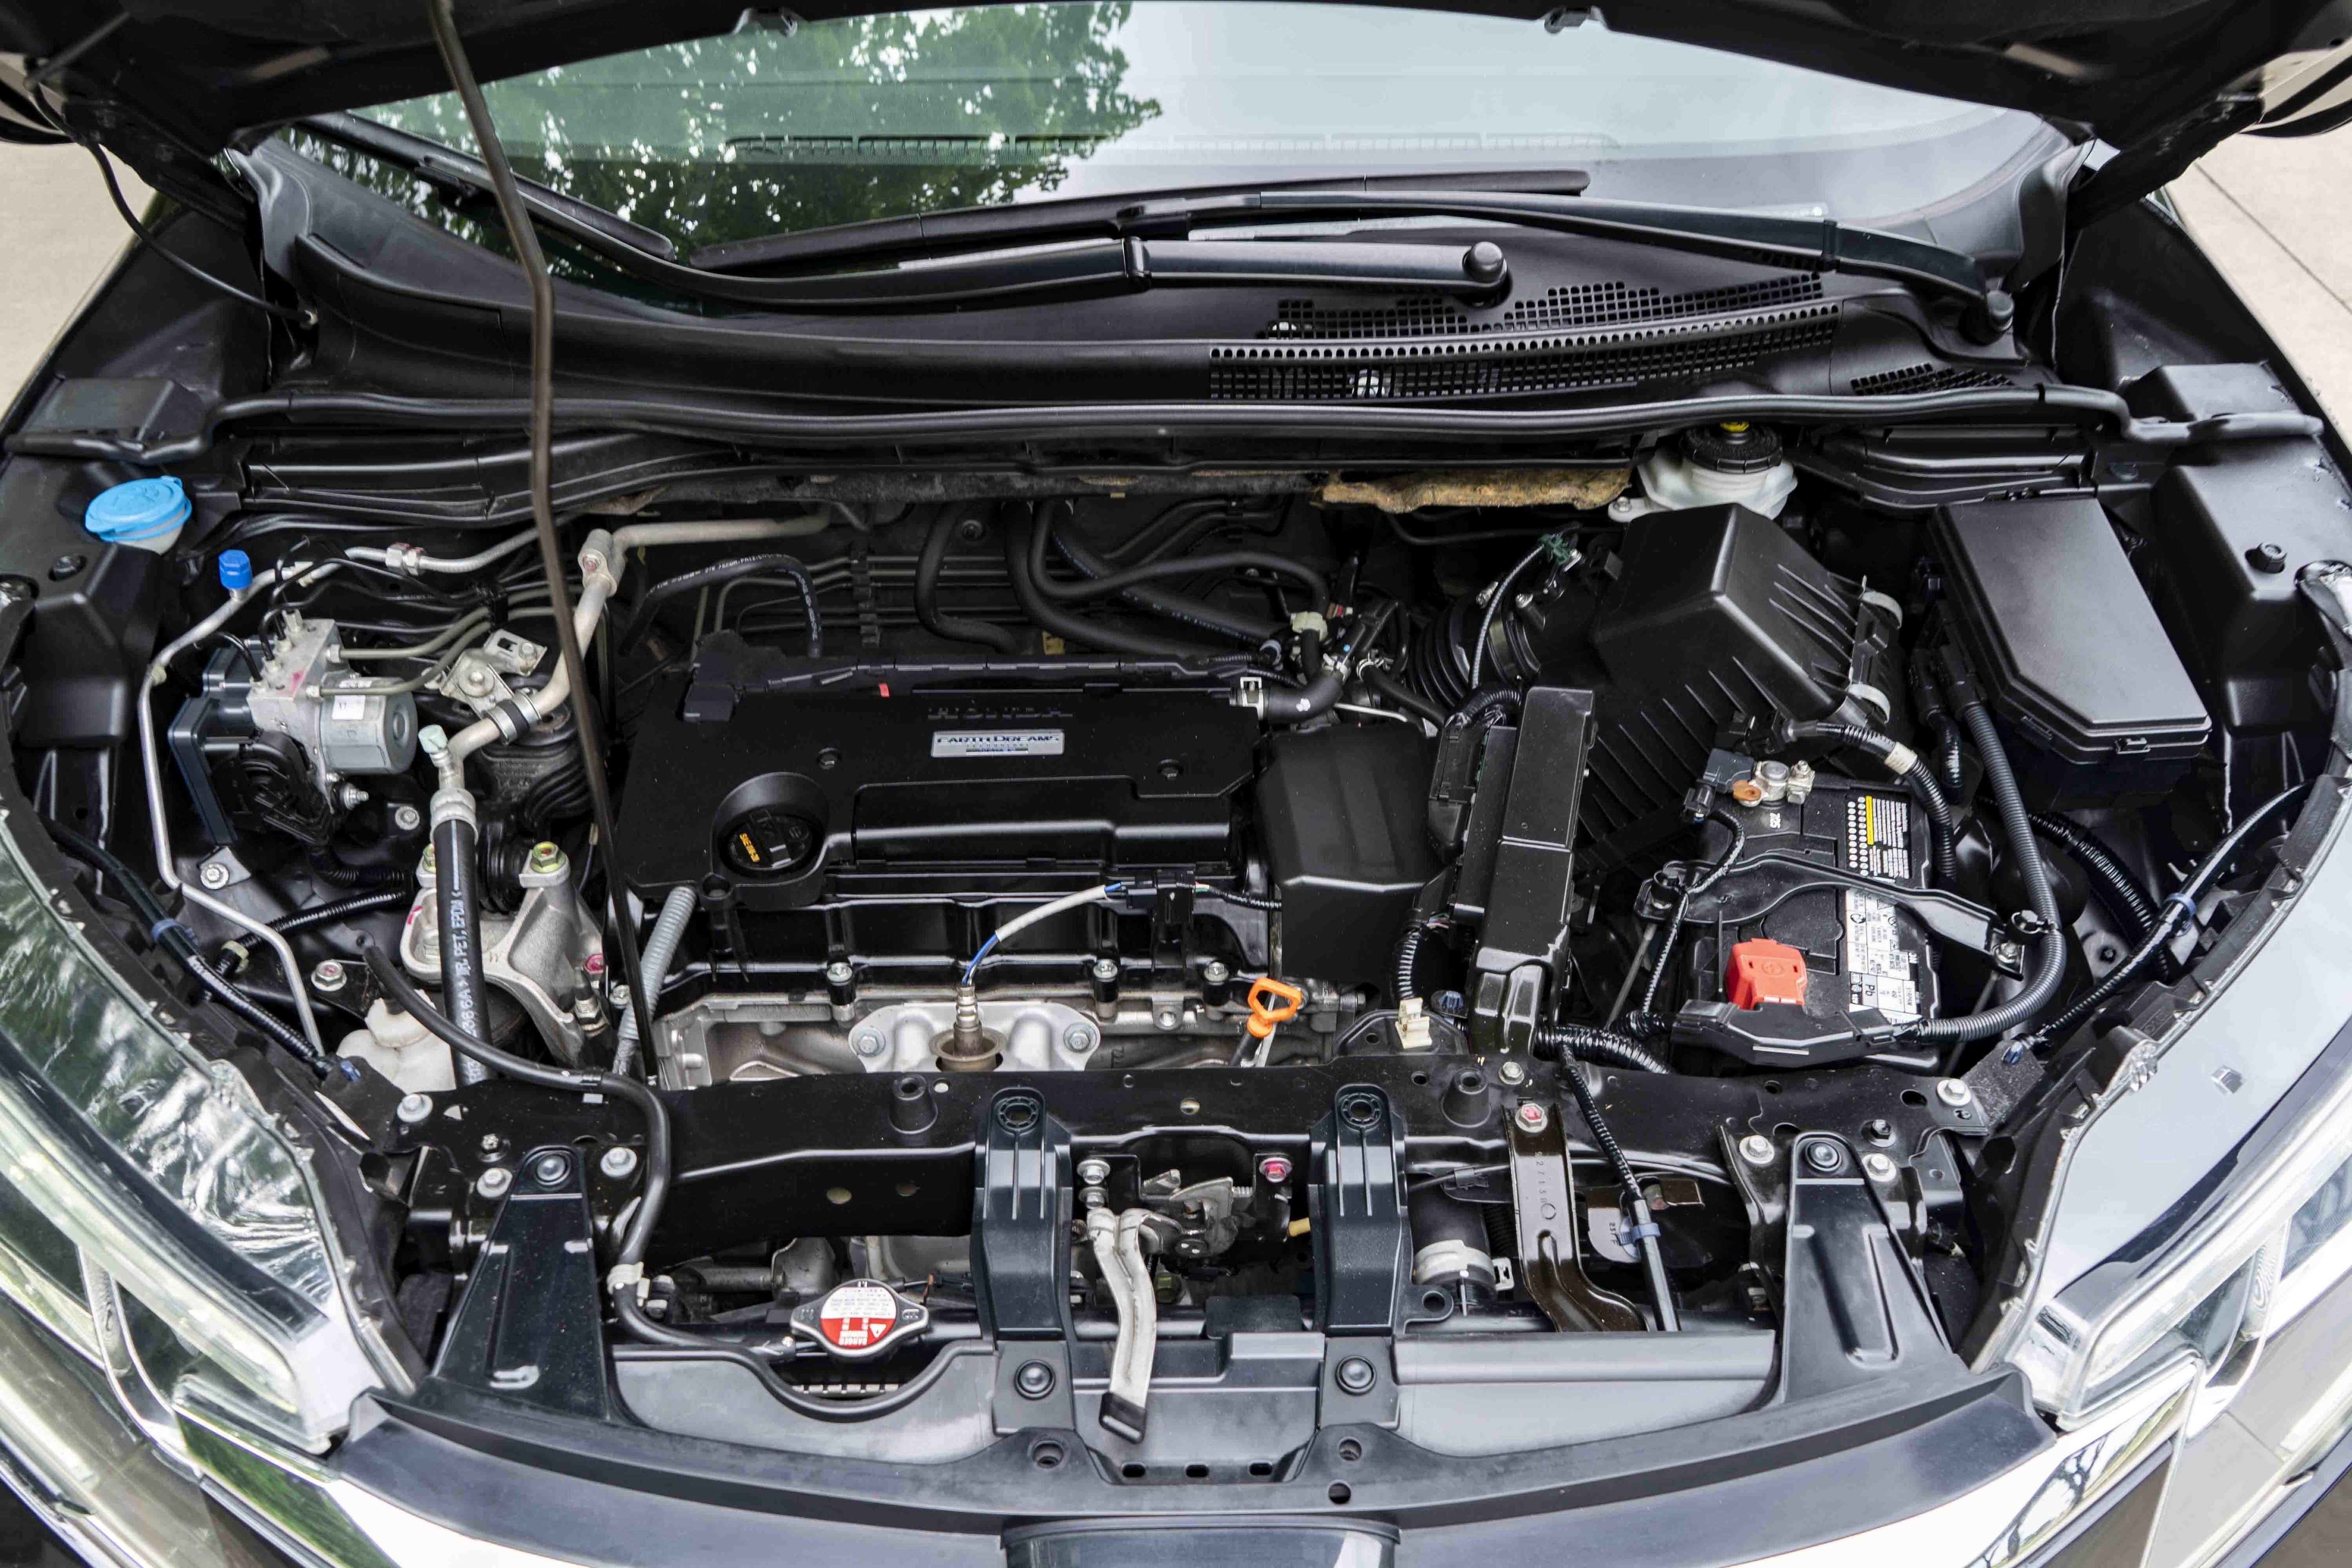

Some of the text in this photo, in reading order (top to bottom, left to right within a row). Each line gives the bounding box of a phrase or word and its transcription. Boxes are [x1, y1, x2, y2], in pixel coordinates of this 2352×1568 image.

[937, 735, 1060, 744] EARTH DREAMS
[1864, 984, 1875, 997] Pb
